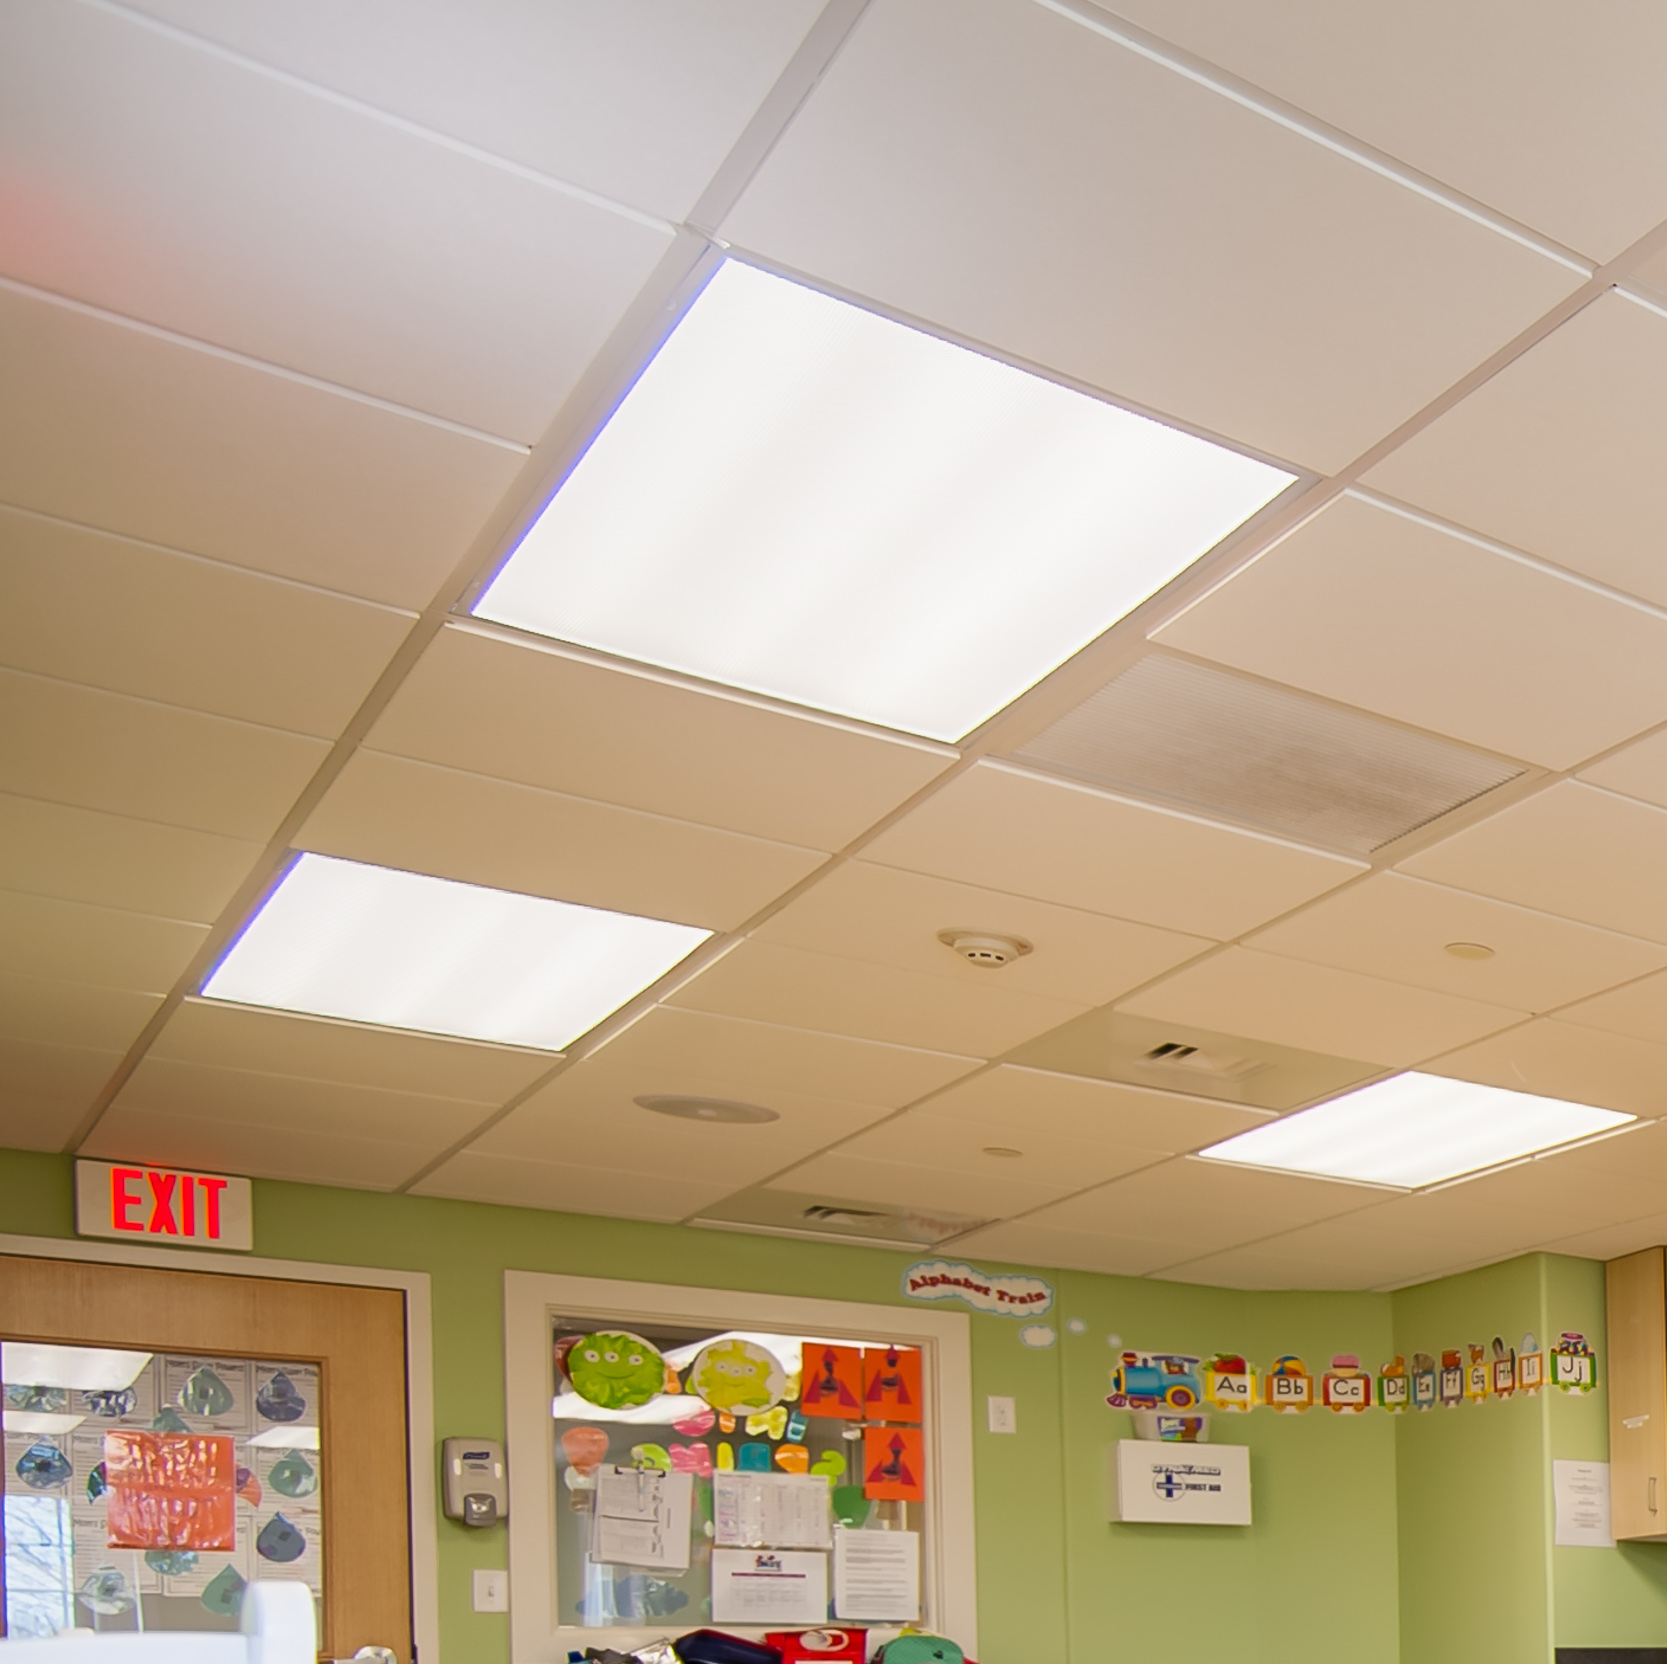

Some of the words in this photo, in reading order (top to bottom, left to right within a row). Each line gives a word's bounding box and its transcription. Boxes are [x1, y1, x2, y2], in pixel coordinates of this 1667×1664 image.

[110, 1167, 227, 1239] EXIT
[909, 1273, 991, 1297] Alphabet
[996, 1289, 1048, 1306] Train
[1471, 1368, 1485, 1389] Gg
[1562, 1356, 1582, 1382] Jj
[1216, 1375, 1248, 1395] Aa
[1276, 1378, 1304, 1396] Bb
[1333, 1379, 1360, 1397] Cc
[1387, 1378, 1405, 1396] Dd
